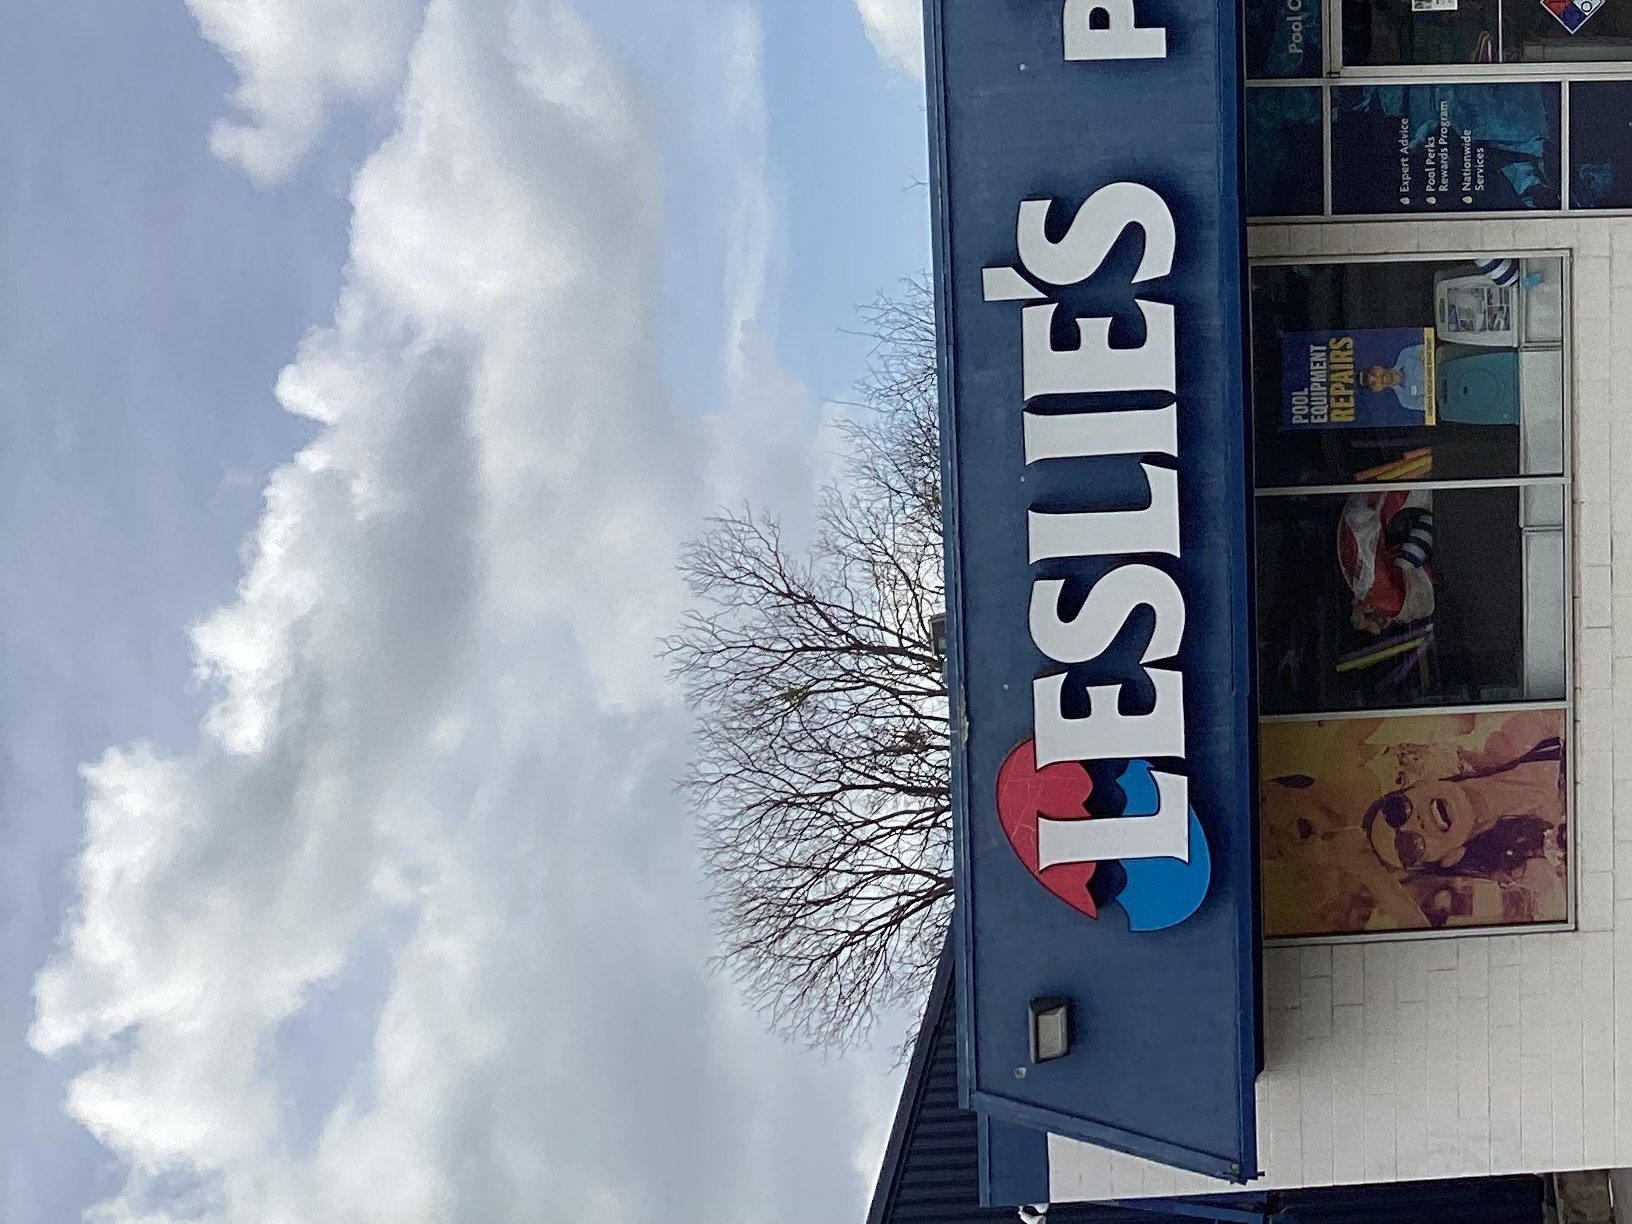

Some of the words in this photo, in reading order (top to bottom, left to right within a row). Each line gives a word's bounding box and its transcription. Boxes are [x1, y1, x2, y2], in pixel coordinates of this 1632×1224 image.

[1286, 16, 1303, 53] Pool
[1398, 118, 1409, 154] Advice
[1439, 101, 1451, 144] Program
[1425, 136, 1435, 164] Perks
[1439, 148, 1449, 192] Rewards
[1461, 129, 1472, 191] Nationwide
[1475, 147, 1485, 191] Services
[1399, 157, 1411, 192] Expert
[1425, 168, 1436, 192] Pool
[1309, 344, 1328, 423] EQUIPMENT
[1328, 336, 1355, 422] REPAIRS
[1292, 388, 1309, 423] POOL
[982, 182, 1190, 874] LESLIE'S
